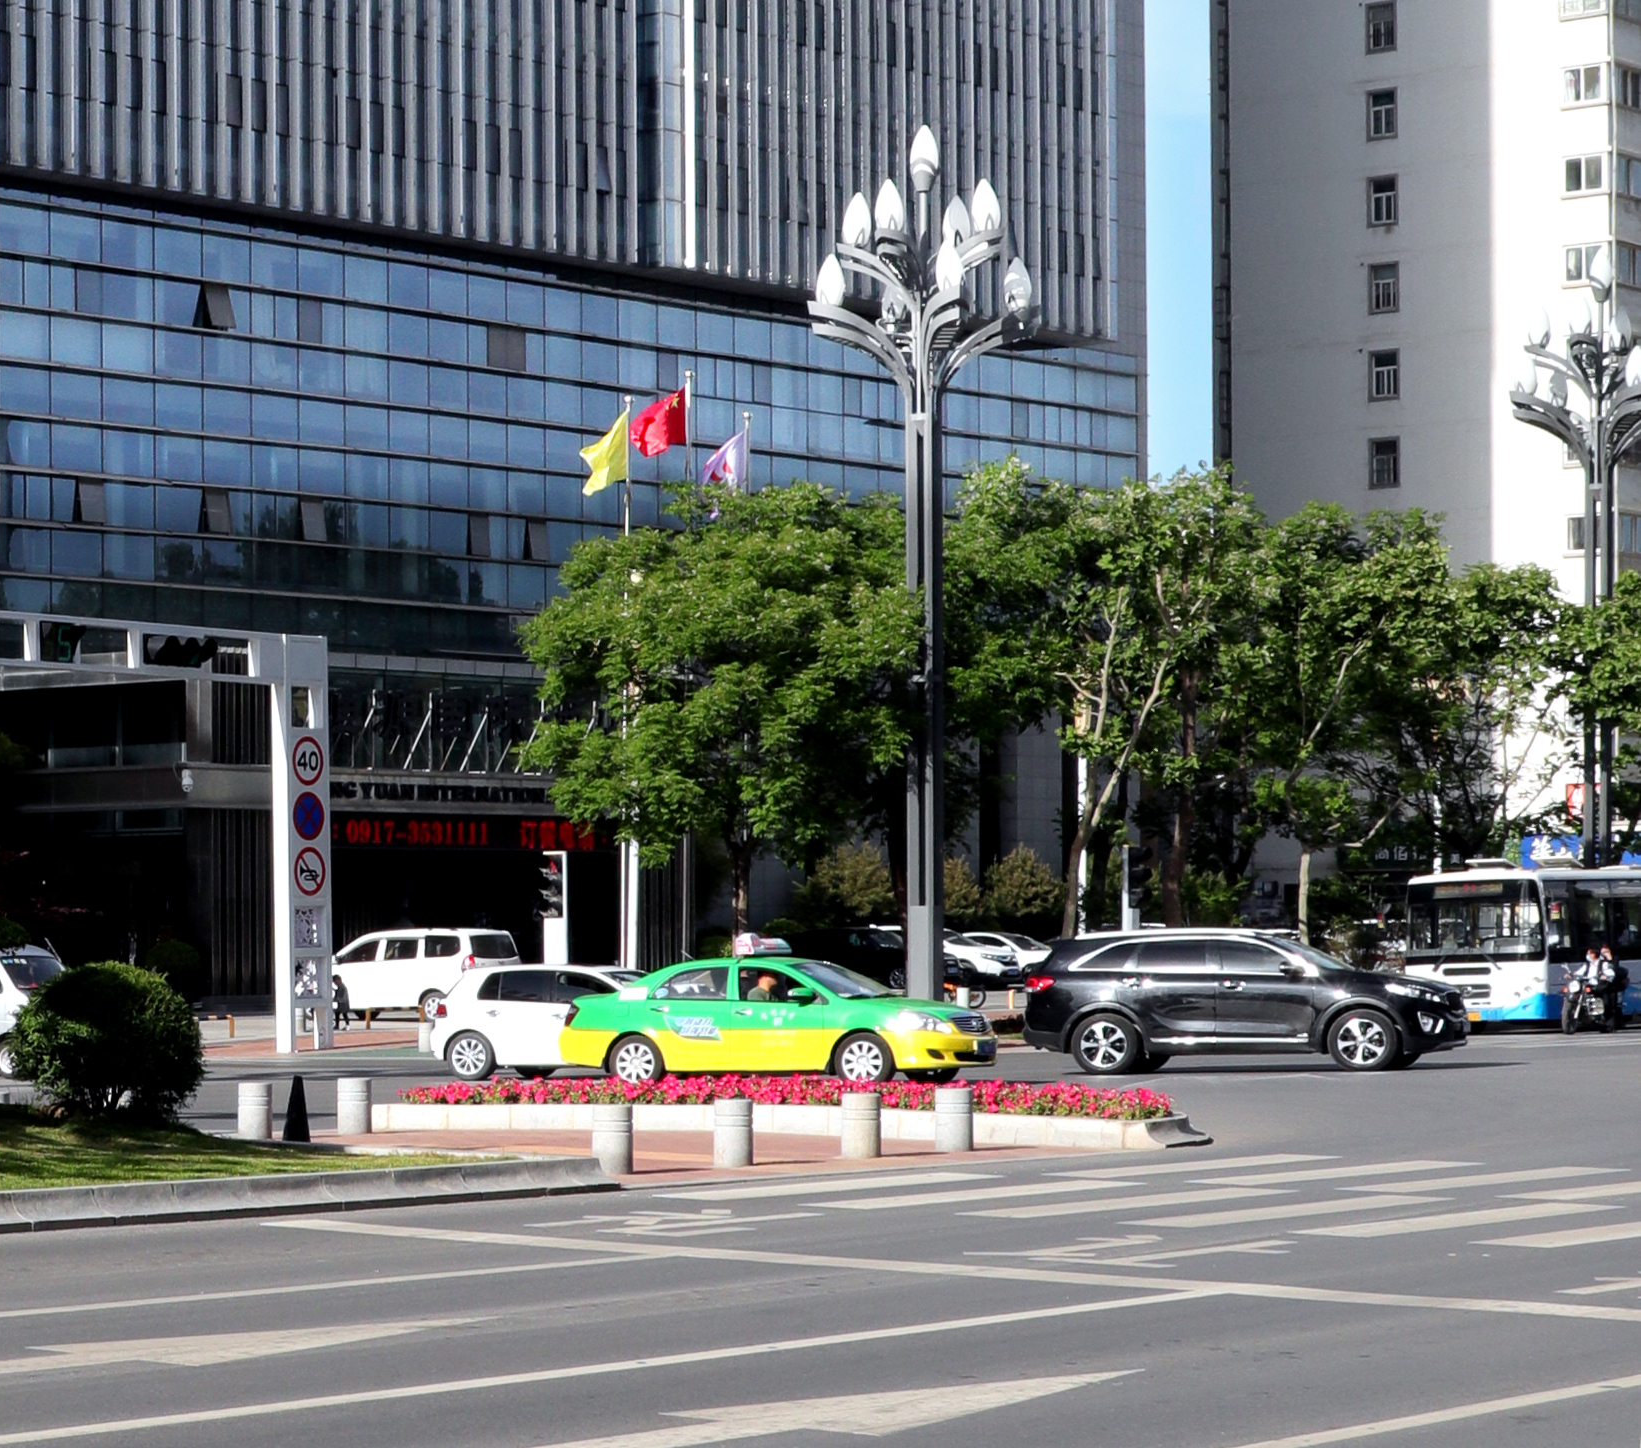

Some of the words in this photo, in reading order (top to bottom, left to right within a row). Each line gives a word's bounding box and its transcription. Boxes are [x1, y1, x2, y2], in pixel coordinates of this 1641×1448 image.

[297, 751, 319, 772] 40
[330, 781, 358, 799] NG
[359, 782, 415, 801] YUAN
[418, 784, 549, 803] INTERNATION
